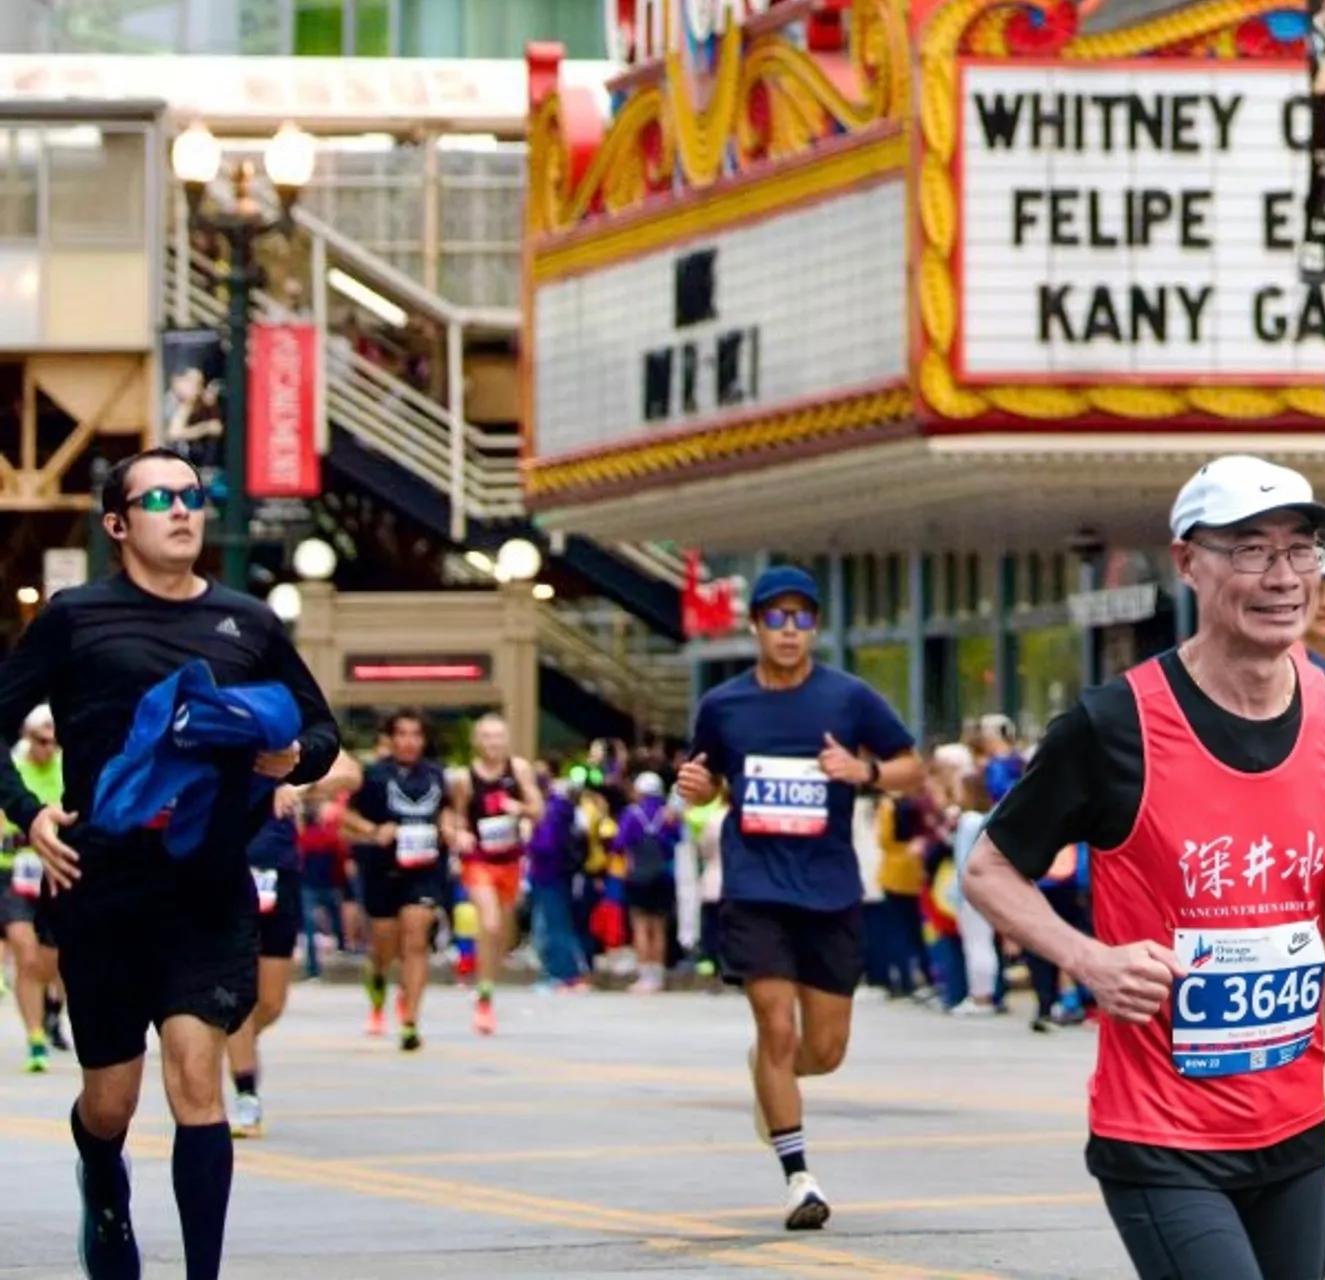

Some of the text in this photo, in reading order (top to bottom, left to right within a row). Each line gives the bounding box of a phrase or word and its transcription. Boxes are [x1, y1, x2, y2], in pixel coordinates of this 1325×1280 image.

[974, 93, 1243, 151] WHITNEY
[1013, 190, 1212, 248] FELIPE
[1037, 285, 1213, 343] KANY
[745, 780, 760, 802] A
[1178, 830, 1325, 900] 深井冰
[1177, 966, 1321, 1023] C 3646
